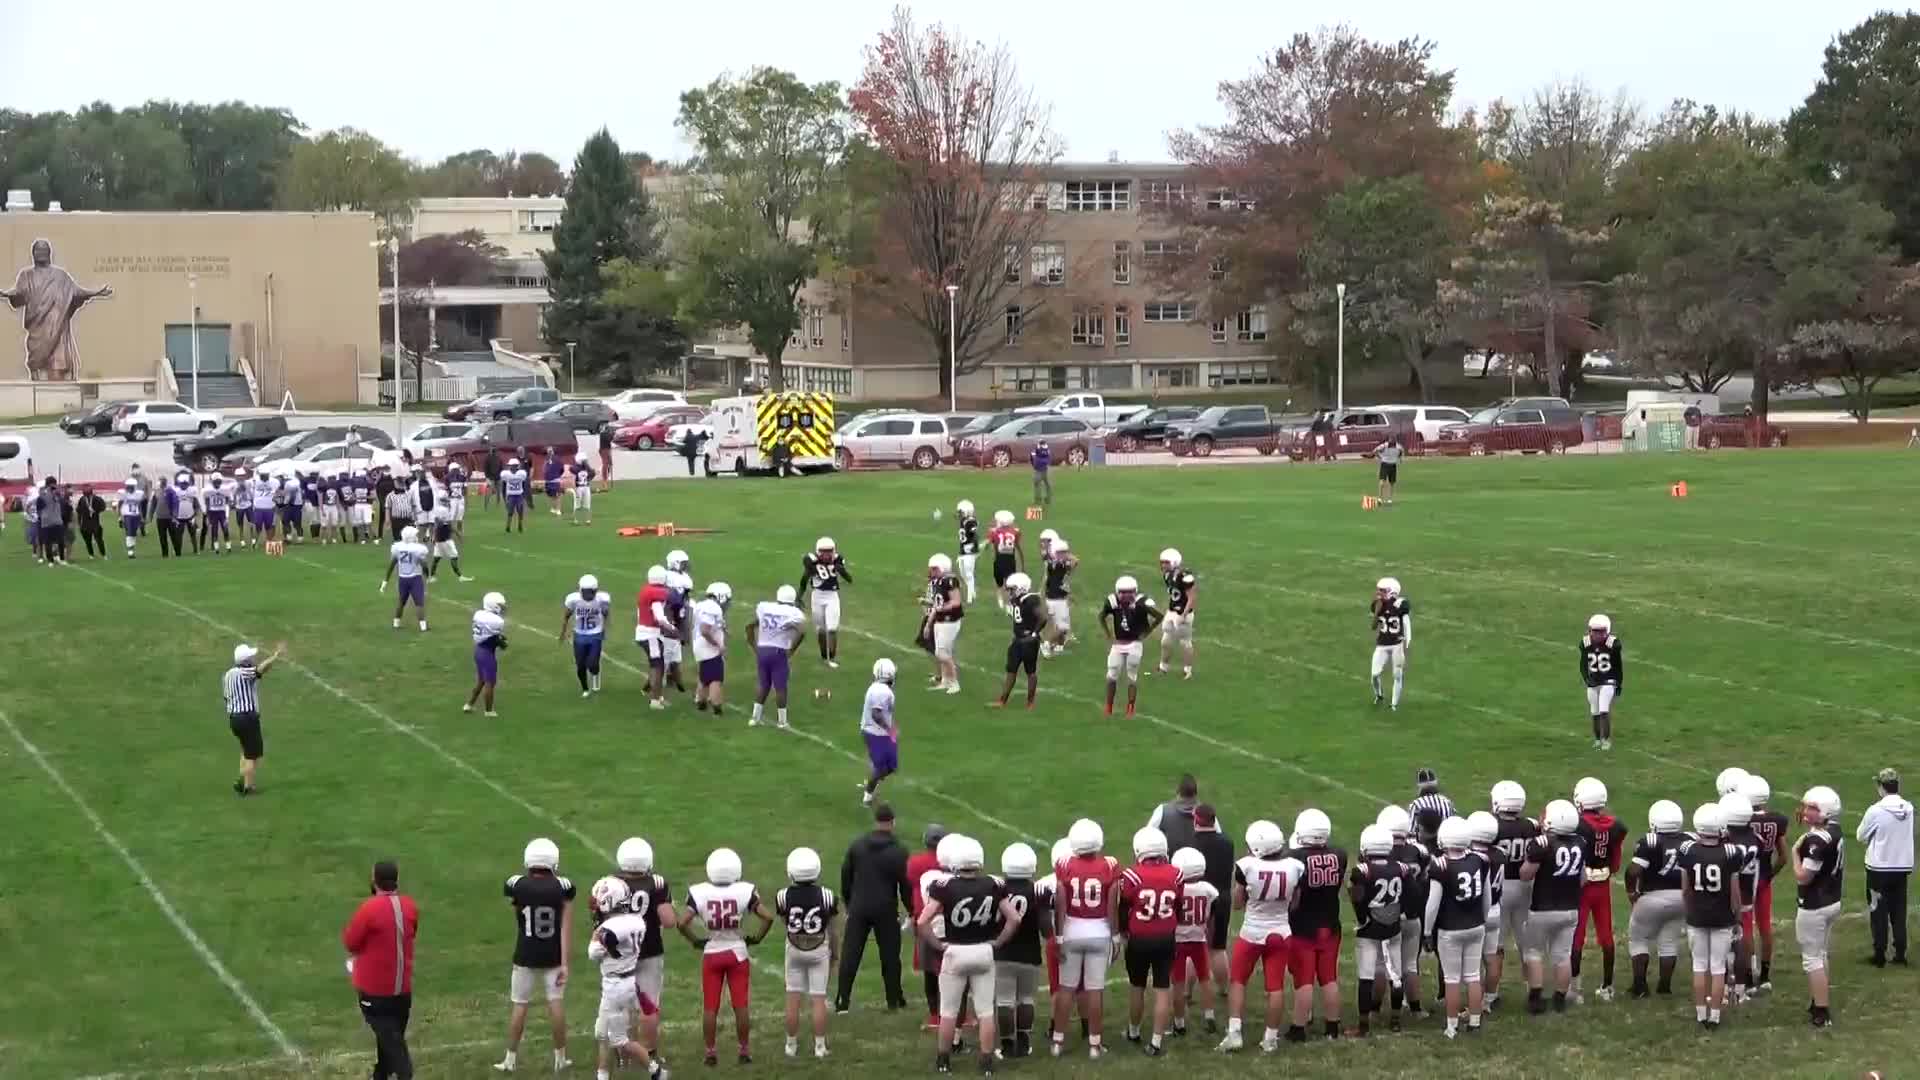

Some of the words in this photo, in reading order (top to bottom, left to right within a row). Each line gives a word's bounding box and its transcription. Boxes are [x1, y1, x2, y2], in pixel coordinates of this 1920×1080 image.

[400, 551, 412, 564] 21
[581, 616, 597, 630] 16
[1587, 652, 1612, 673] 26
[1307, 853, 1340, 888] 62
[1552, 845, 1582, 876] 92
[1070, 877, 1102, 908] 10
[1258, 870, 1287, 901] 71
[1367, 876, 1403, 908] 29
[1455, 869, 1482, 901] 31
[1693, 862, 1722, 892] 19
[521, 904, 556, 939] 18
[706, 899, 739, 930] 32
[951, 895, 994, 928] 64
